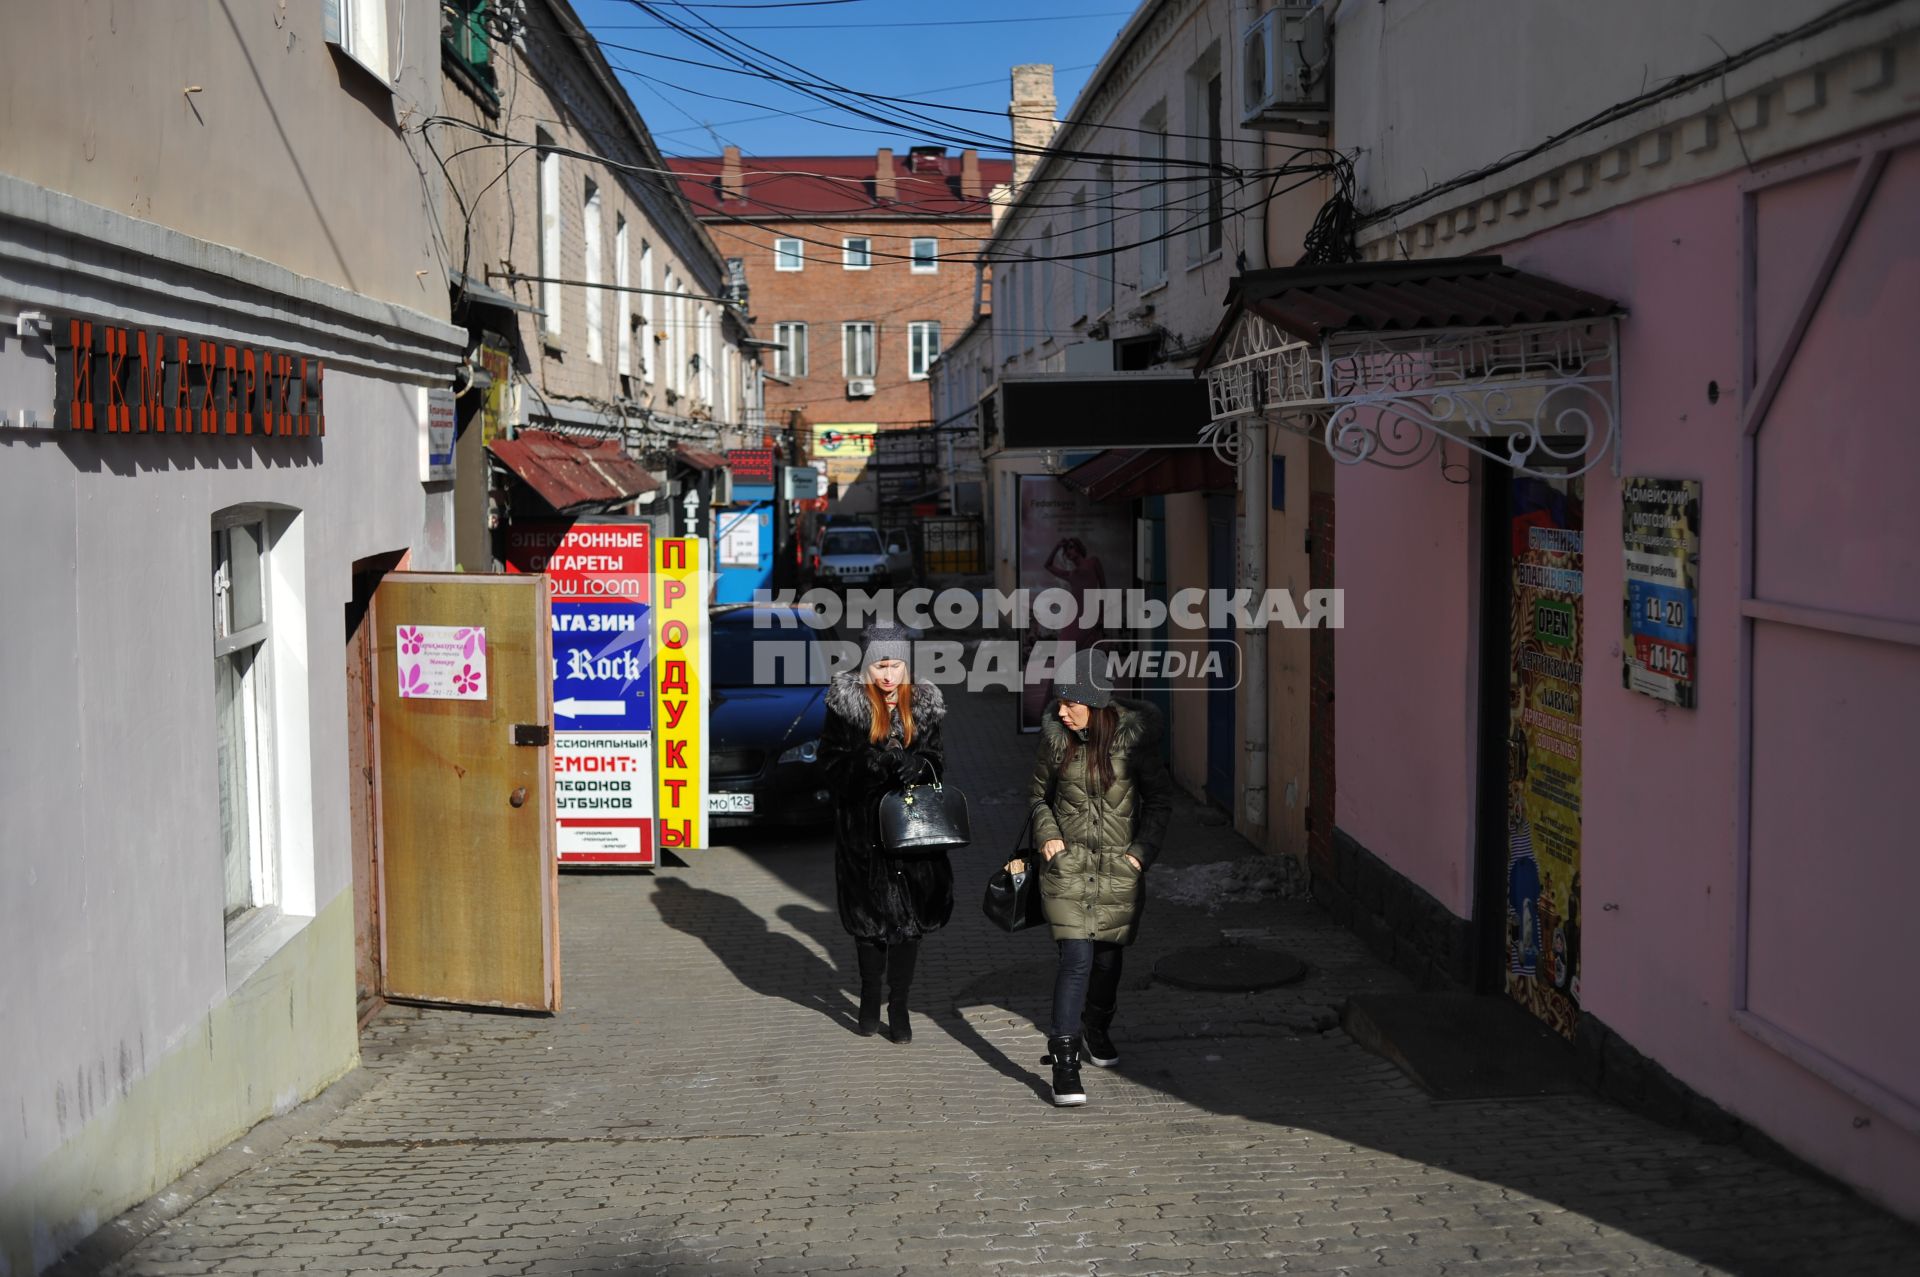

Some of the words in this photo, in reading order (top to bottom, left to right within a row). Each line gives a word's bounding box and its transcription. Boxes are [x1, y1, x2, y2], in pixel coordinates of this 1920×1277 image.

[1624, 486, 1688, 505] Армейский
[1633, 512, 1677, 528] магазин
[511, 532, 643, 548] ЭЛЕКТРОННЫЕ
[530, 555, 623, 571] СИГАРЕТЫ
[584, 579, 639, 595] room
[1539, 607, 1570, 637] OPEN
[566, 648, 641, 680] Rock
[660, 540, 691, 847] ПРОДУКТЫ
[555, 738, 648, 749] ССИОНАЛЬНЫЙ
[557, 798, 633, 808] УТБУКОВ
[730, 796, 751, 806] 125
